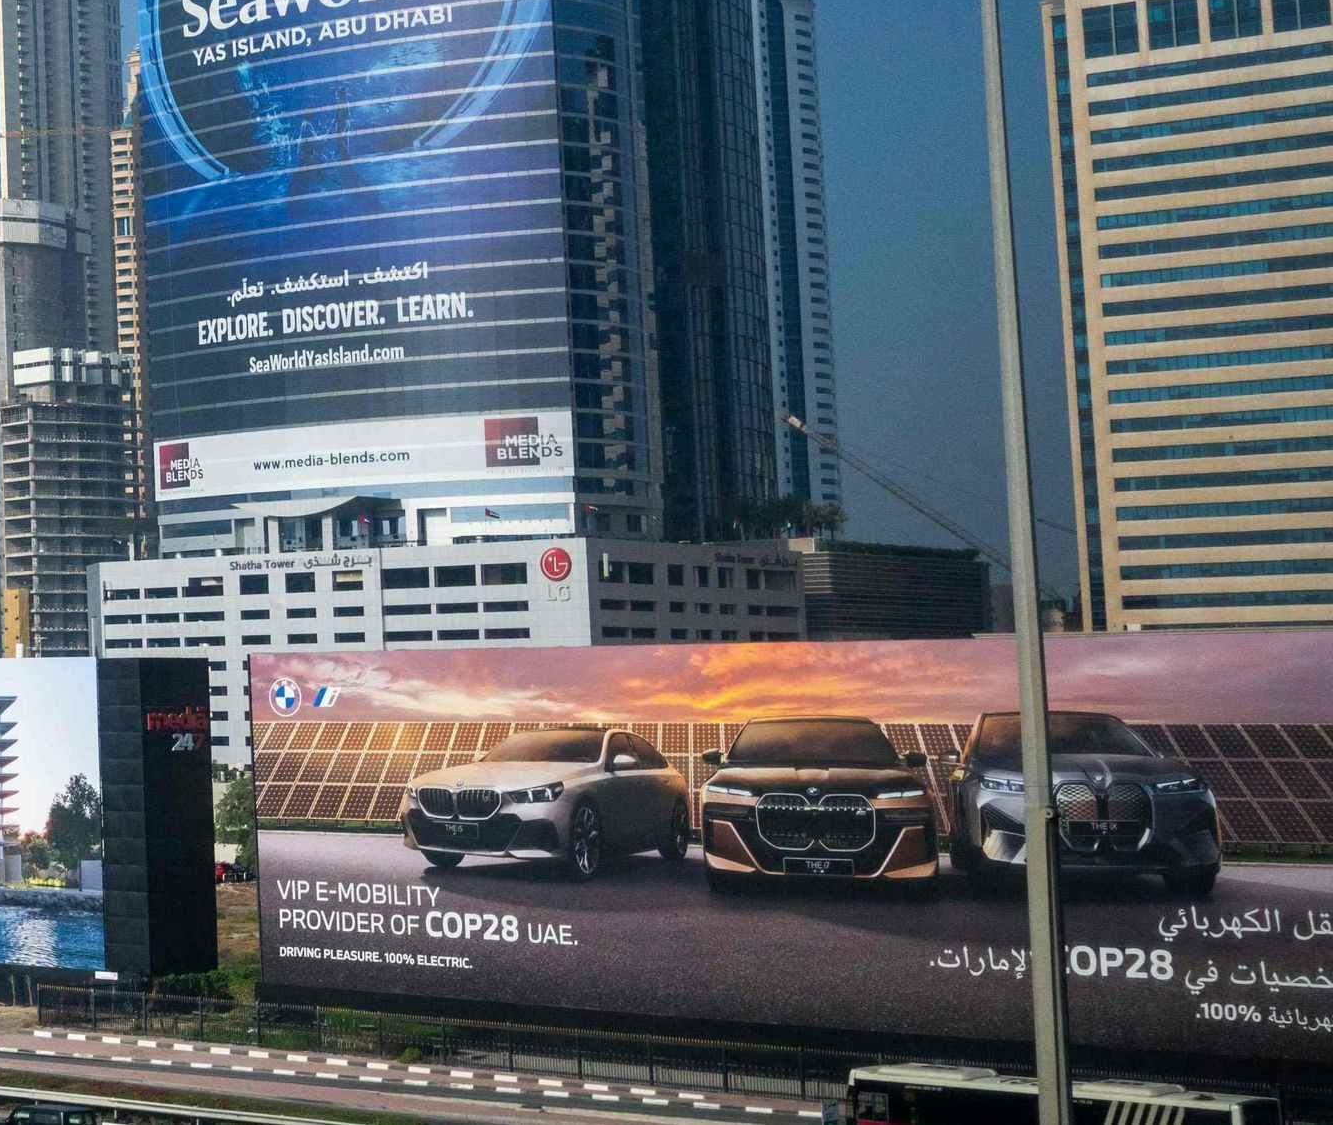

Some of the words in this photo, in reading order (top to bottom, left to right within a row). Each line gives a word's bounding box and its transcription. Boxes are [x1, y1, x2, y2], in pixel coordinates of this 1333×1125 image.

[193, 42, 226, 67] YAS
[232, 29, 312, 59] ISLAND,
[318, 17, 367, 42] ABU
[375, 5, 453, 32] DHABI
[198, 311, 273, 345] EXPLORE.
[282, 299, 385, 334] DISCOVER.
[397, 291, 474, 323] LEARN.
[249, 343, 404, 374] SeaWorldYasIsland.com
[505, 433, 558, 447] MEDIA
[170, 457, 201, 471] MEDIA
[253, 449, 411, 472] www.media-blends.com
[496, 446, 563, 460] BLENDS
[165, 469, 204, 483] BLENDS
[230, 560, 262, 571] Shatha
[264, 559, 295, 569] Tower
[546, 584, 571, 602] LG
[147, 706, 209, 731] media
[276, 880, 310, 900] VIP
[316, 881, 440, 907] E-MOBILITY
[279, 908, 384, 934] PROVIDER
[391, 915, 420, 935] OF
[425, 911, 519, 942] COP28
[528, 923, 579, 946] UAE.
[1158, 905, 1281, 942] الكهربائي
[279, 946, 321, 959] DRIVING
[323, 949, 383, 963] PLEASURE.
[384, 952, 415, 965] 100%
[417, 954, 473, 969] ELECTRIC.
[1065, 945, 1174, 981] OP28
[1185, 959, 1218, 995] في
